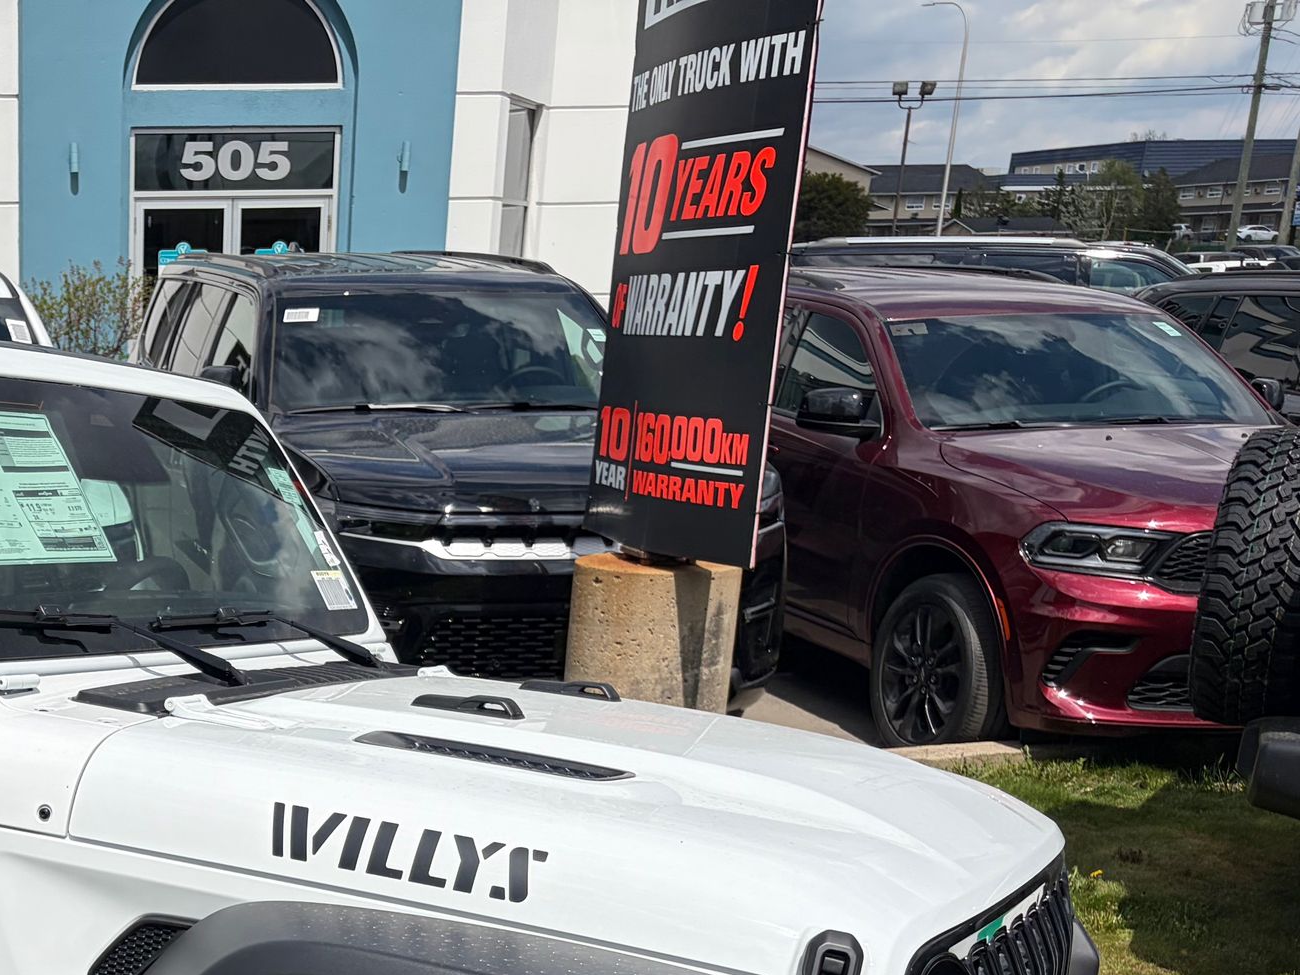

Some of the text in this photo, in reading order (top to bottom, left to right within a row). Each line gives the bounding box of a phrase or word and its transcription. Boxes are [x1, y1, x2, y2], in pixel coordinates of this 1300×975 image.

[632, 29, 807, 113] THE ONLY TRUCK WITH
[179, 140, 291, 181] 505
[619, 133, 777, 255] 10 YEARS
[612, 283, 629, 328] OF
[599, 406, 631, 462] 10
[595, 460, 626, 491] YEAR
[632, 469, 745, 509] WARRANTY
[272, 802, 549, 903] WILLYS
